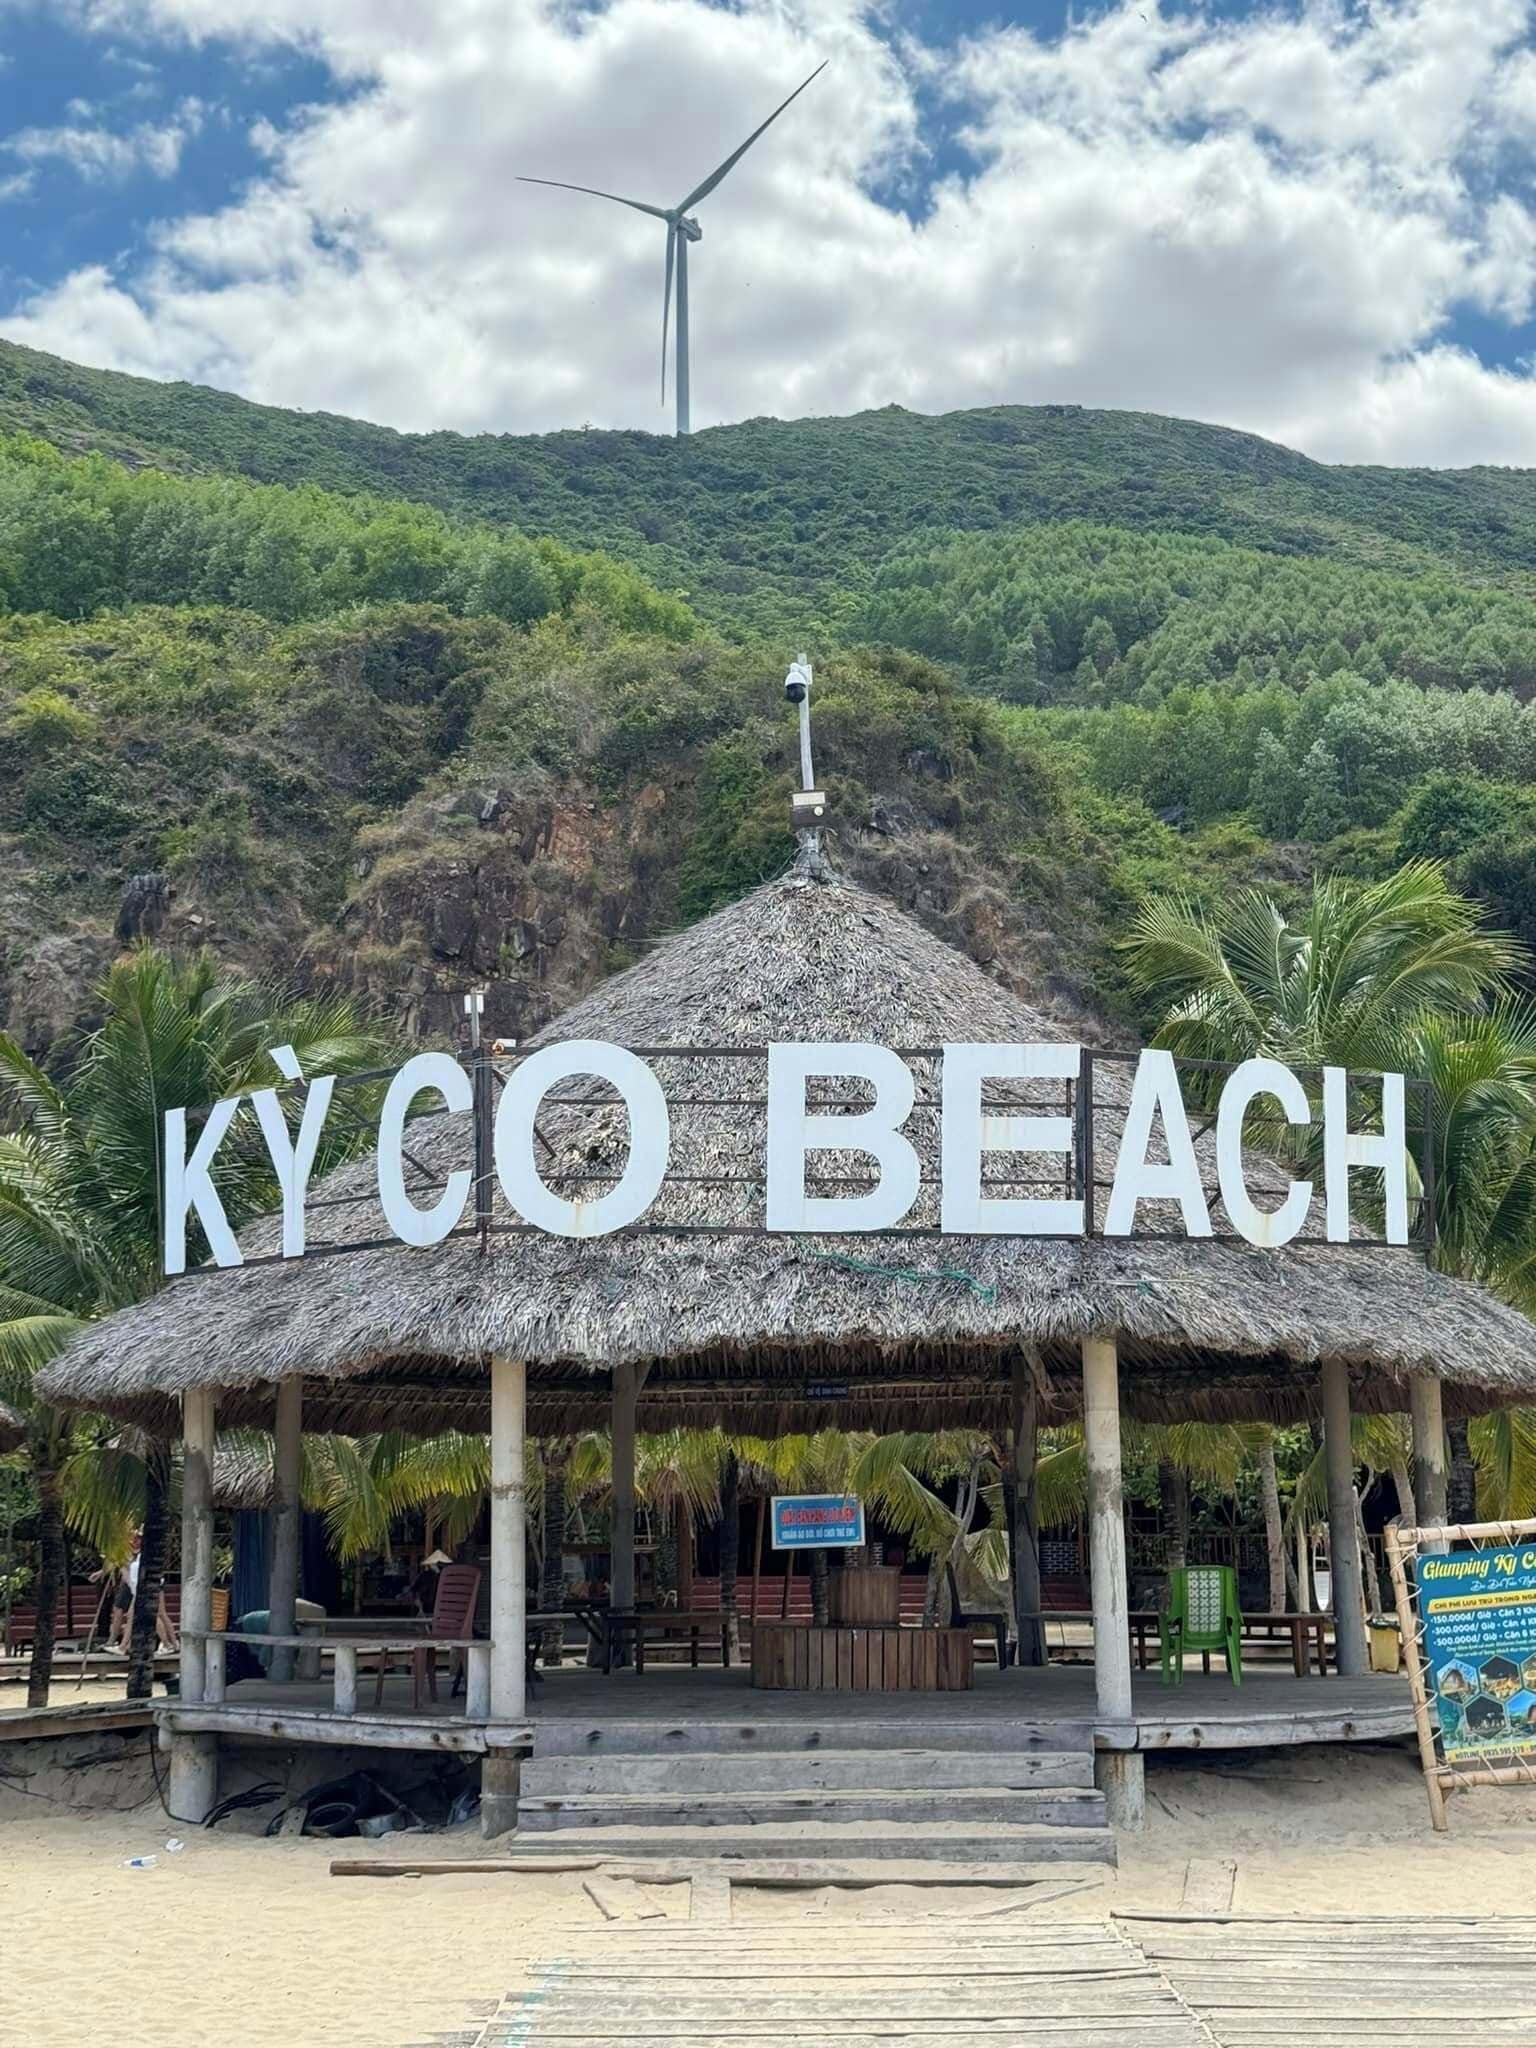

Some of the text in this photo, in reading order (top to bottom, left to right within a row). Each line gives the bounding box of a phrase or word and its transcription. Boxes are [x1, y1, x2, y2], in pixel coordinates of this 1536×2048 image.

[164, 1039, 1409, 1275] KỲ CO BEACH
[1423, 1557, 1490, 1580] Glamping
